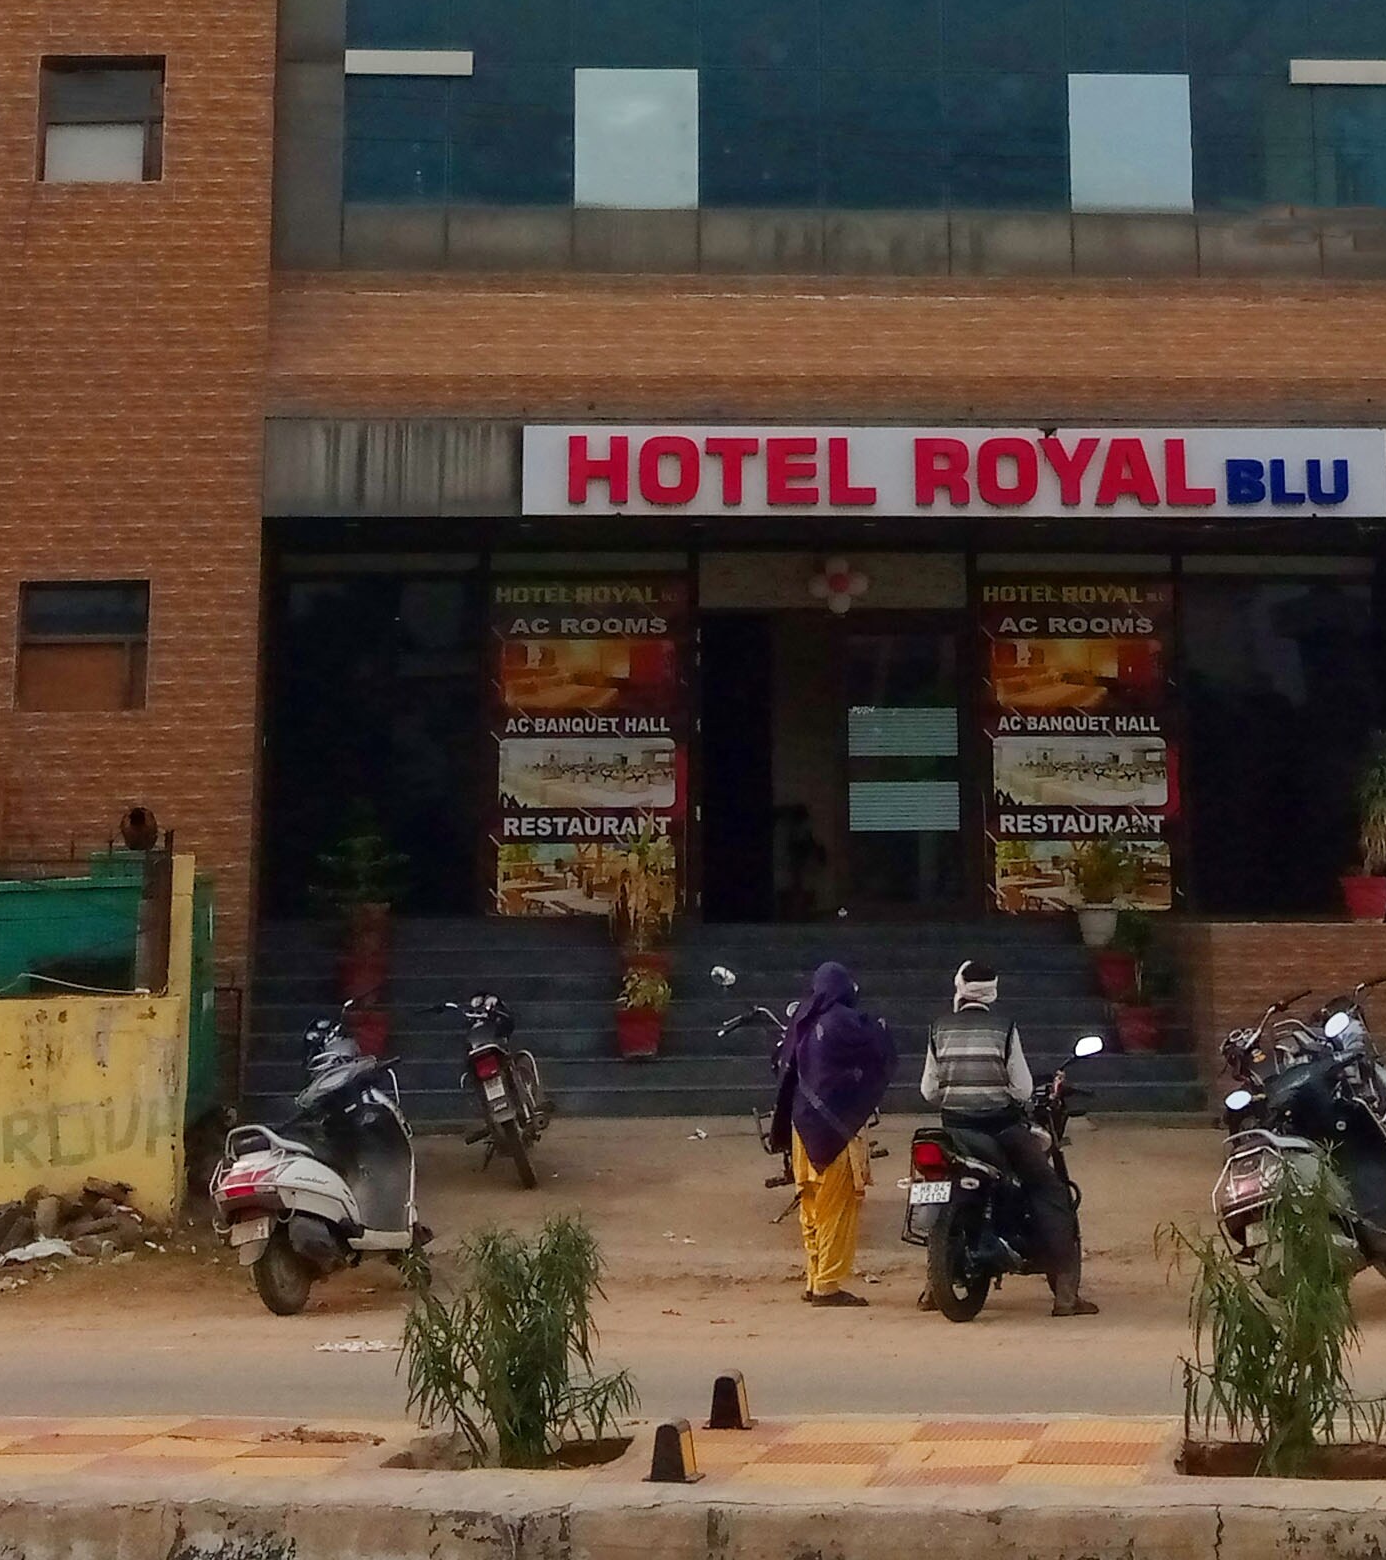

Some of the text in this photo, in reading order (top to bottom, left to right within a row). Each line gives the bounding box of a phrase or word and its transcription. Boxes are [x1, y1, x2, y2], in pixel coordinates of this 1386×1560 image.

[567, 434, 1349, 509] HOTEL ROYAL BLU
[495, 587, 570, 603] HOTEL
[574, 587, 658, 603] ROYAL
[983, 586, 1058, 602] HOTEL
[1061, 586, 1143, 603] ROYAL
[510, 618, 668, 634] AC ROOMS
[999, 617, 1154, 634] AC ROOMS
[505, 717, 670, 733] AC BANQUET HALL
[998, 716, 1160, 732] AC BANQUET HALL
[503, 816, 672, 836] RESTAURANT
[999, 814, 1165, 834] RESTAURANT
